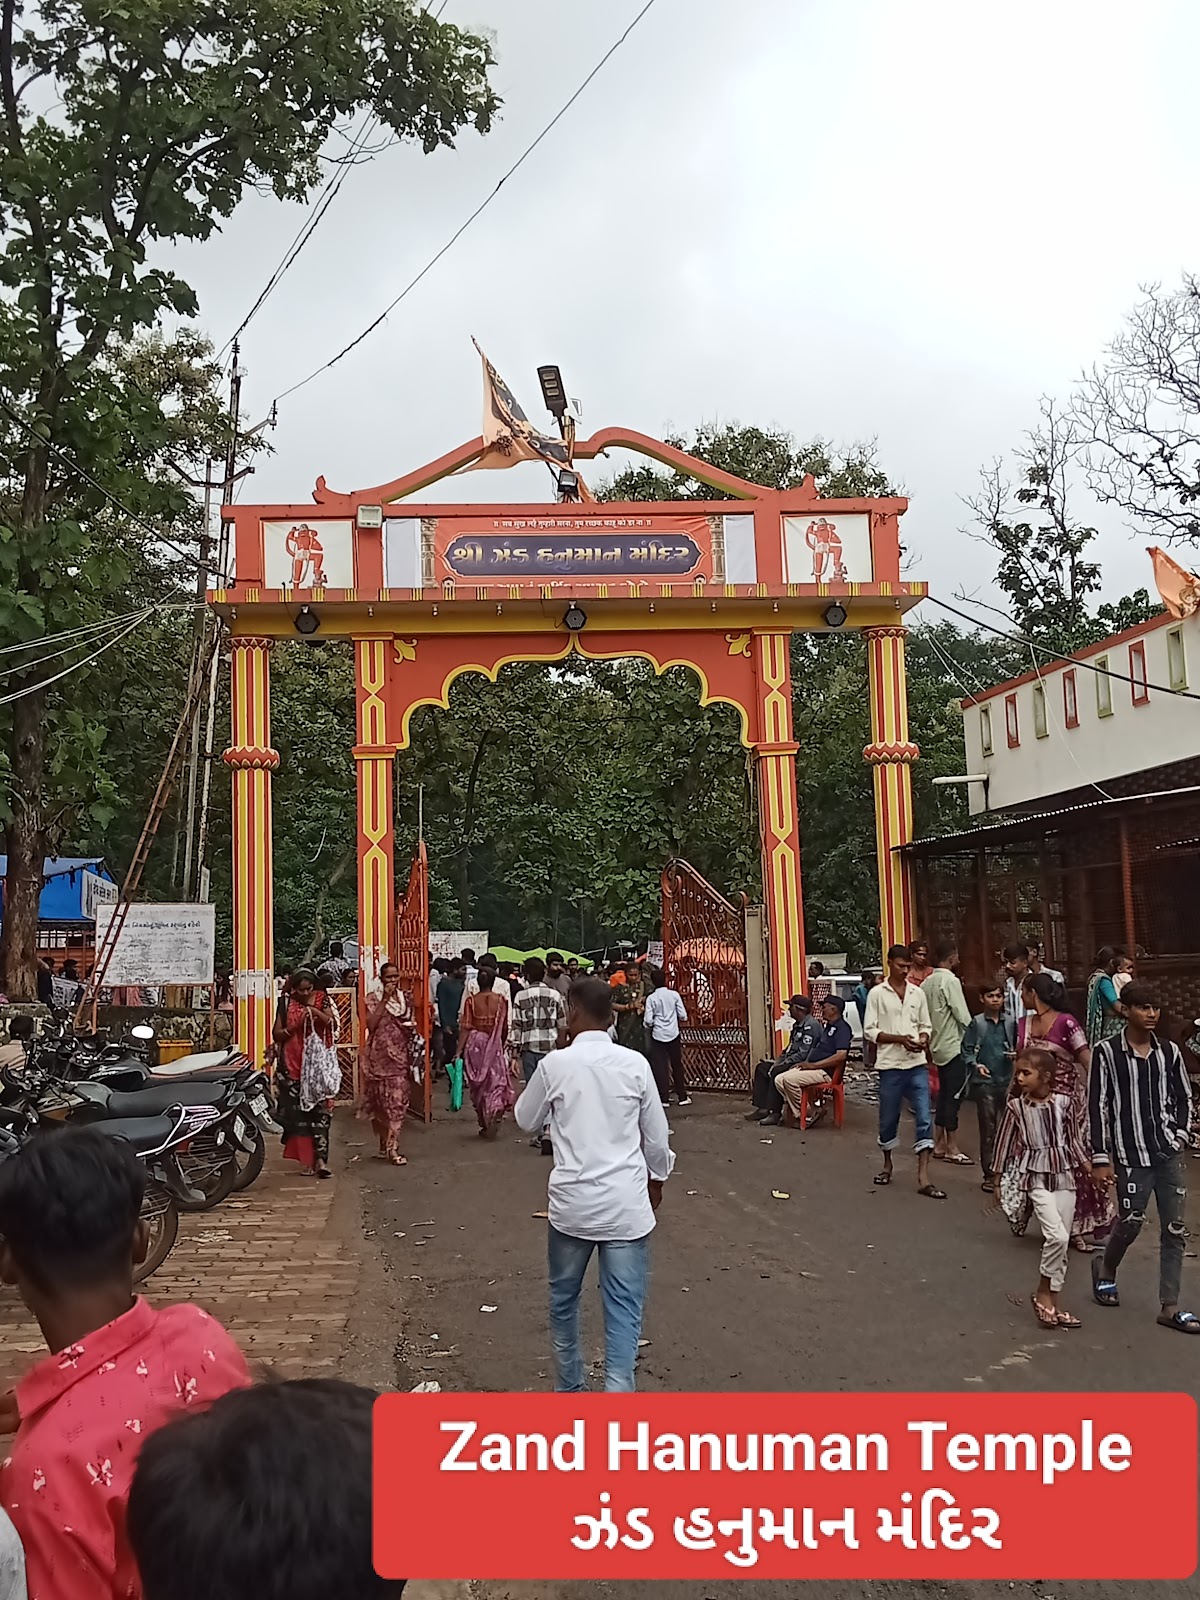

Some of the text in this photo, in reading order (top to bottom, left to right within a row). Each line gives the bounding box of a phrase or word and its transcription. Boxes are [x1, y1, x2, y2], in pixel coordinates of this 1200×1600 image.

[452, 542, 483, 564] શ્રી
[536, 547, 622, 571] હનુમાન
[629, 540, 690, 564] મંદિર
